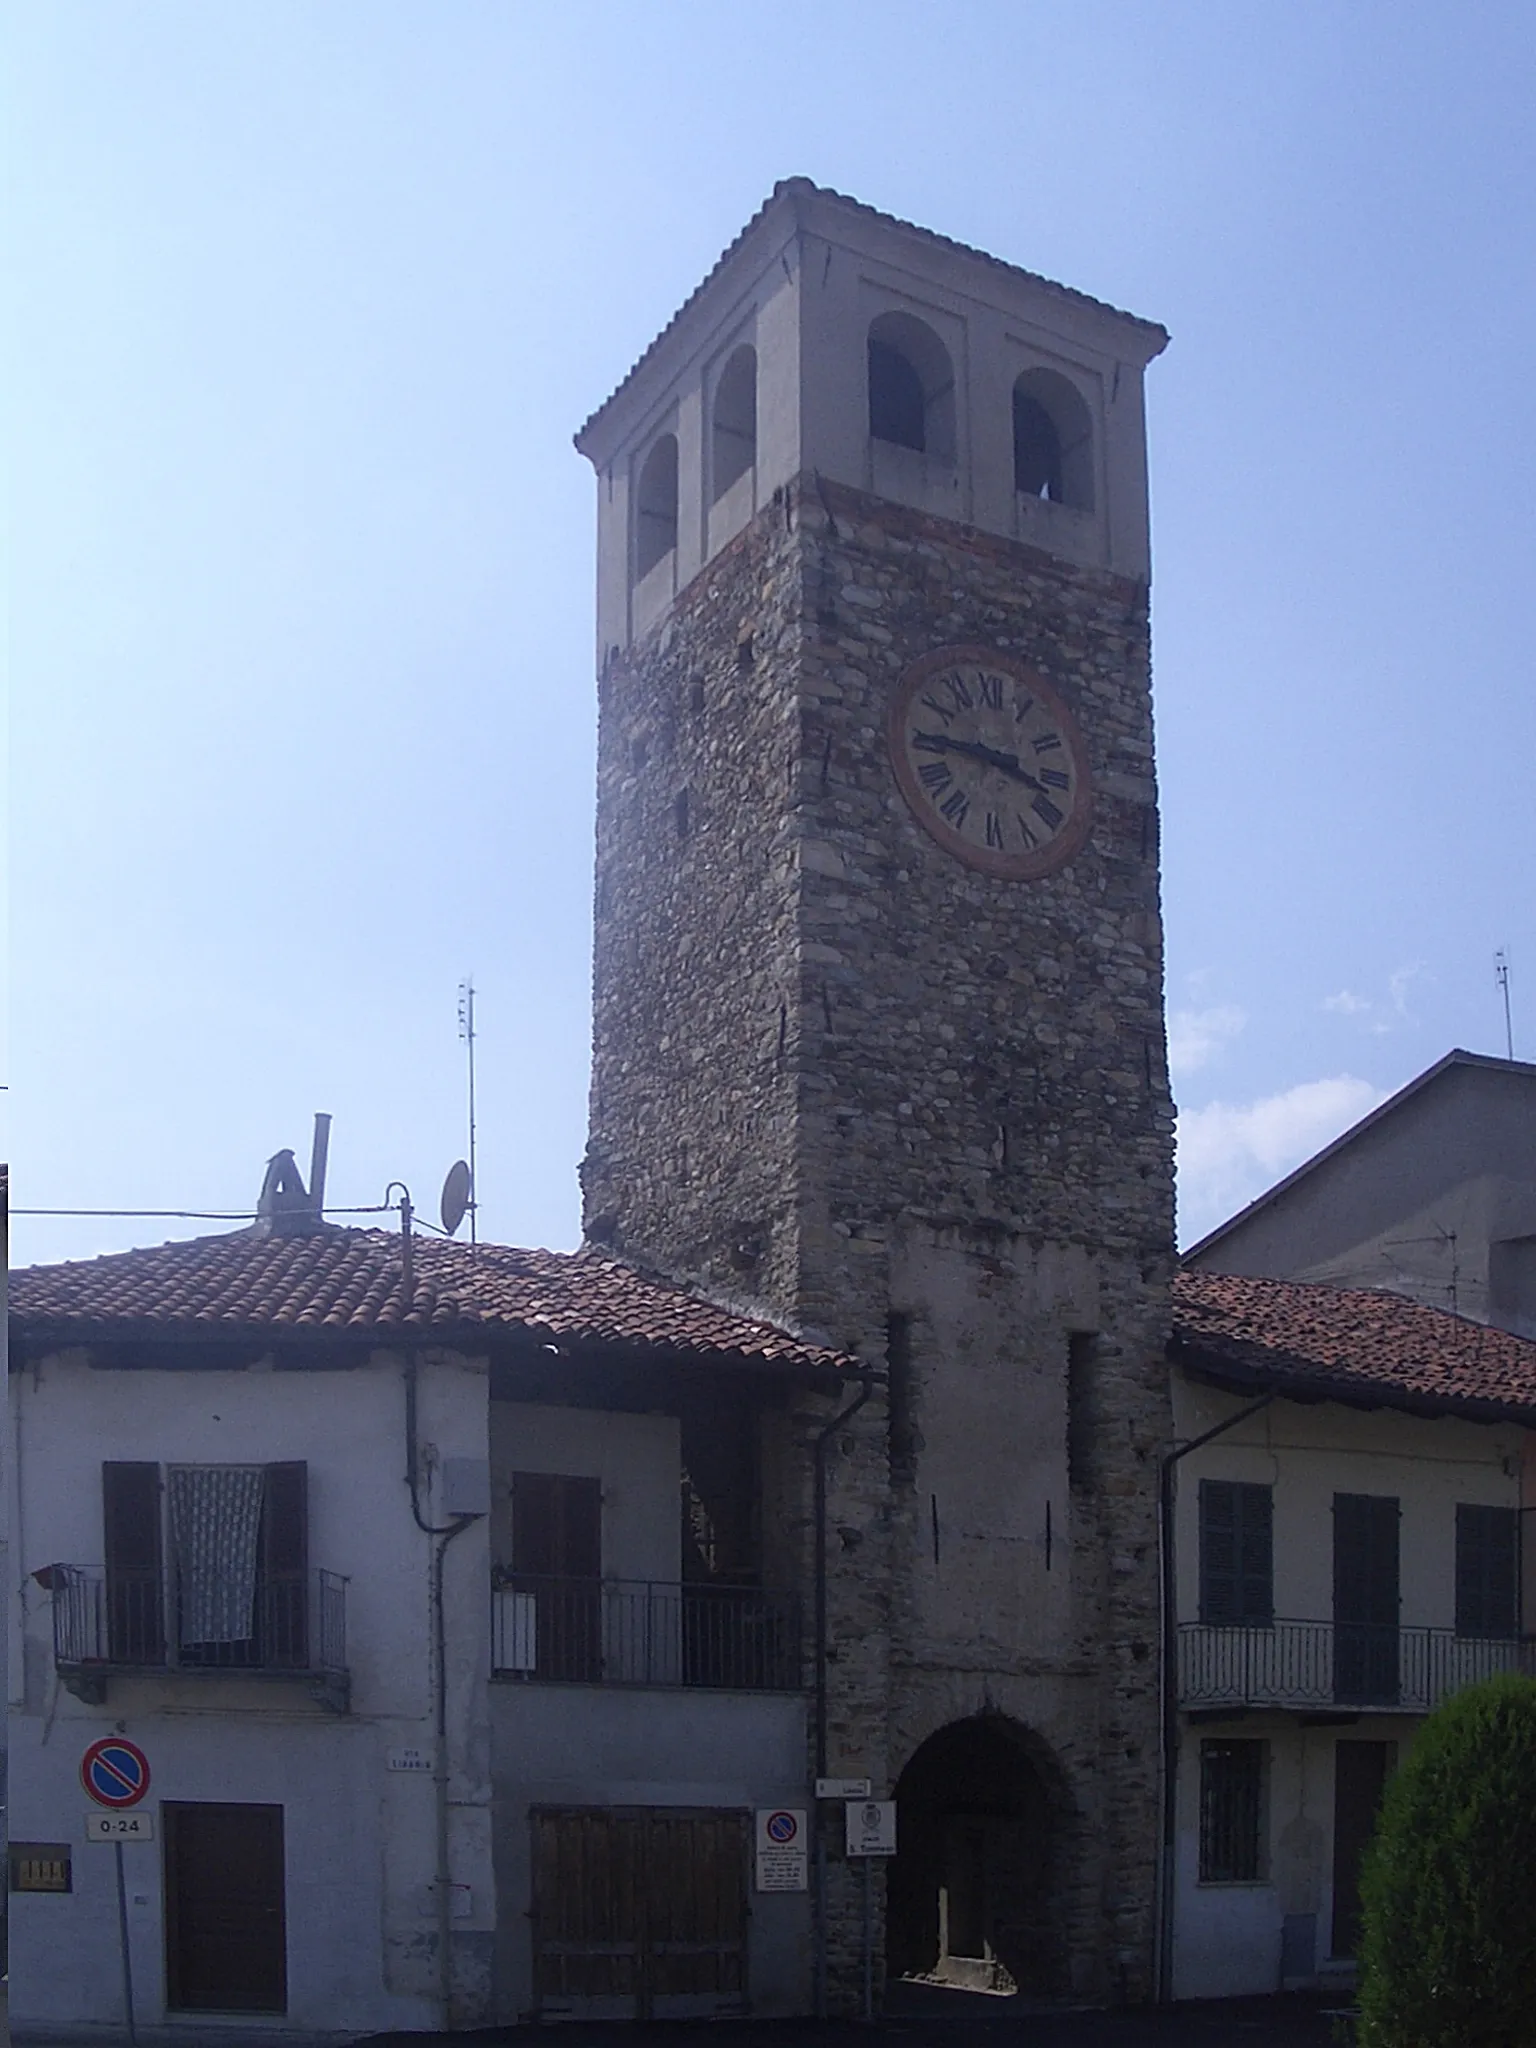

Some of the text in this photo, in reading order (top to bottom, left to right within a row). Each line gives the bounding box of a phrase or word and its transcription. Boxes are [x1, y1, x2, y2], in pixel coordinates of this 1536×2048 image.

[977, 671, 1003, 710] XII
[921, 693, 955, 726] X
[1017, 813, 1039, 849] V
[100, 1820, 140, 1833] 0-24
